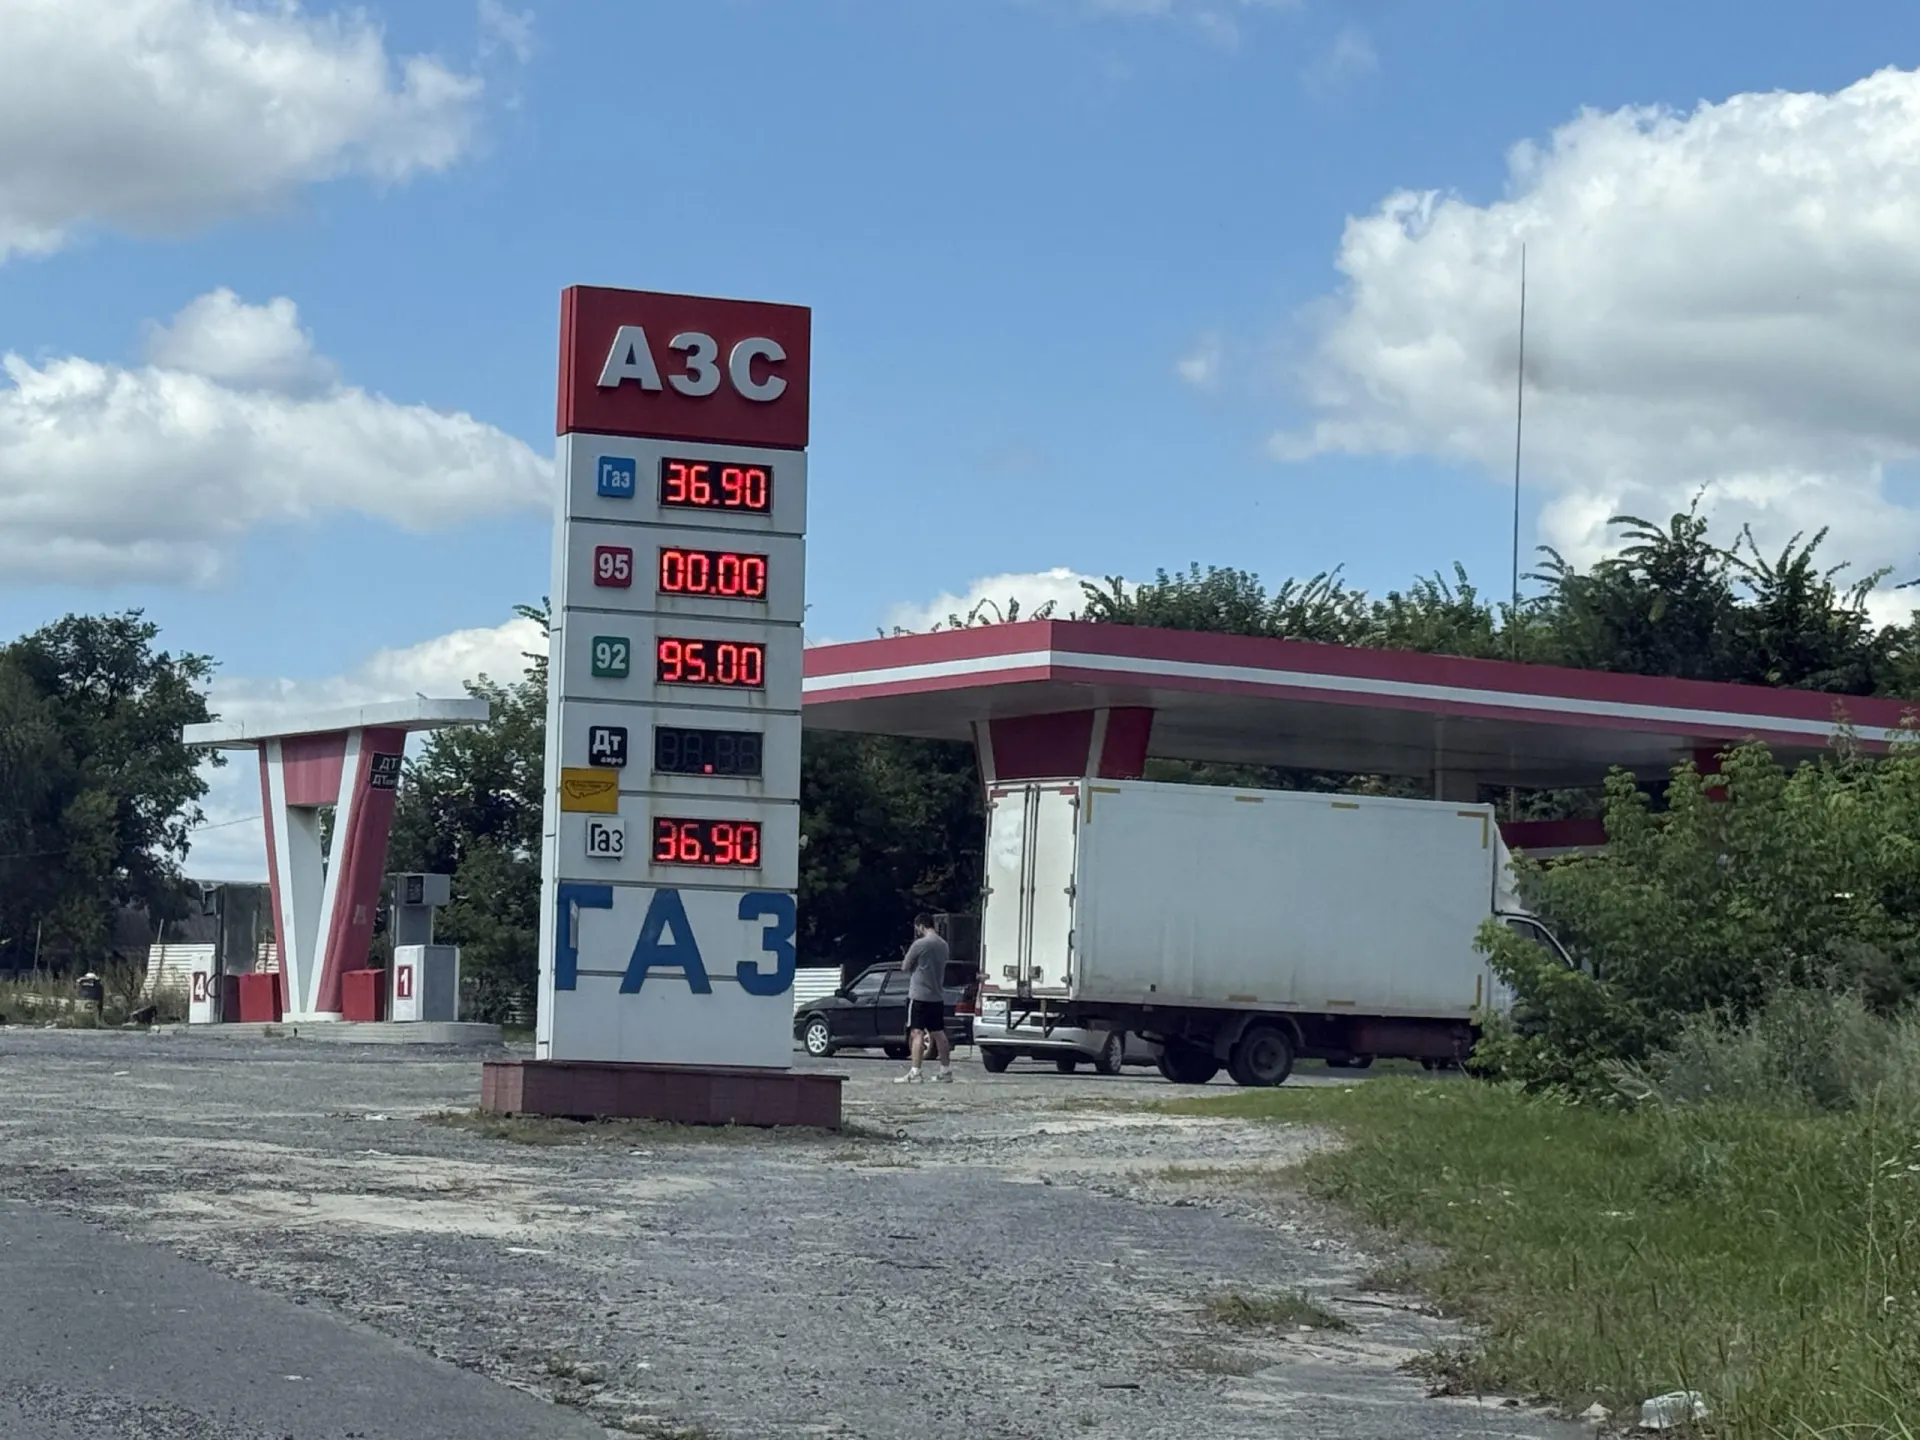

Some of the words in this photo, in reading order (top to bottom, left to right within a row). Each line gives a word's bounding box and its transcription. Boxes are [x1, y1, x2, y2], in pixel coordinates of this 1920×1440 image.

[597, 325, 788, 402] АЗС
[602, 463, 631, 488] Газ
[666, 463, 766, 507] 36.90
[599, 553, 629, 579] 95
[662, 551, 764, 595] 00.00
[596, 643, 626, 669] 92
[659, 640, 761, 684] 95.00
[592, 730, 621, 754] Дт
[590, 823, 624, 852] Газ
[657, 820, 757, 864] 36.90
[555, 884, 796, 996] ГАЗ
[194, 975, 205, 999] 4
[400, 968, 409, 995] 1
